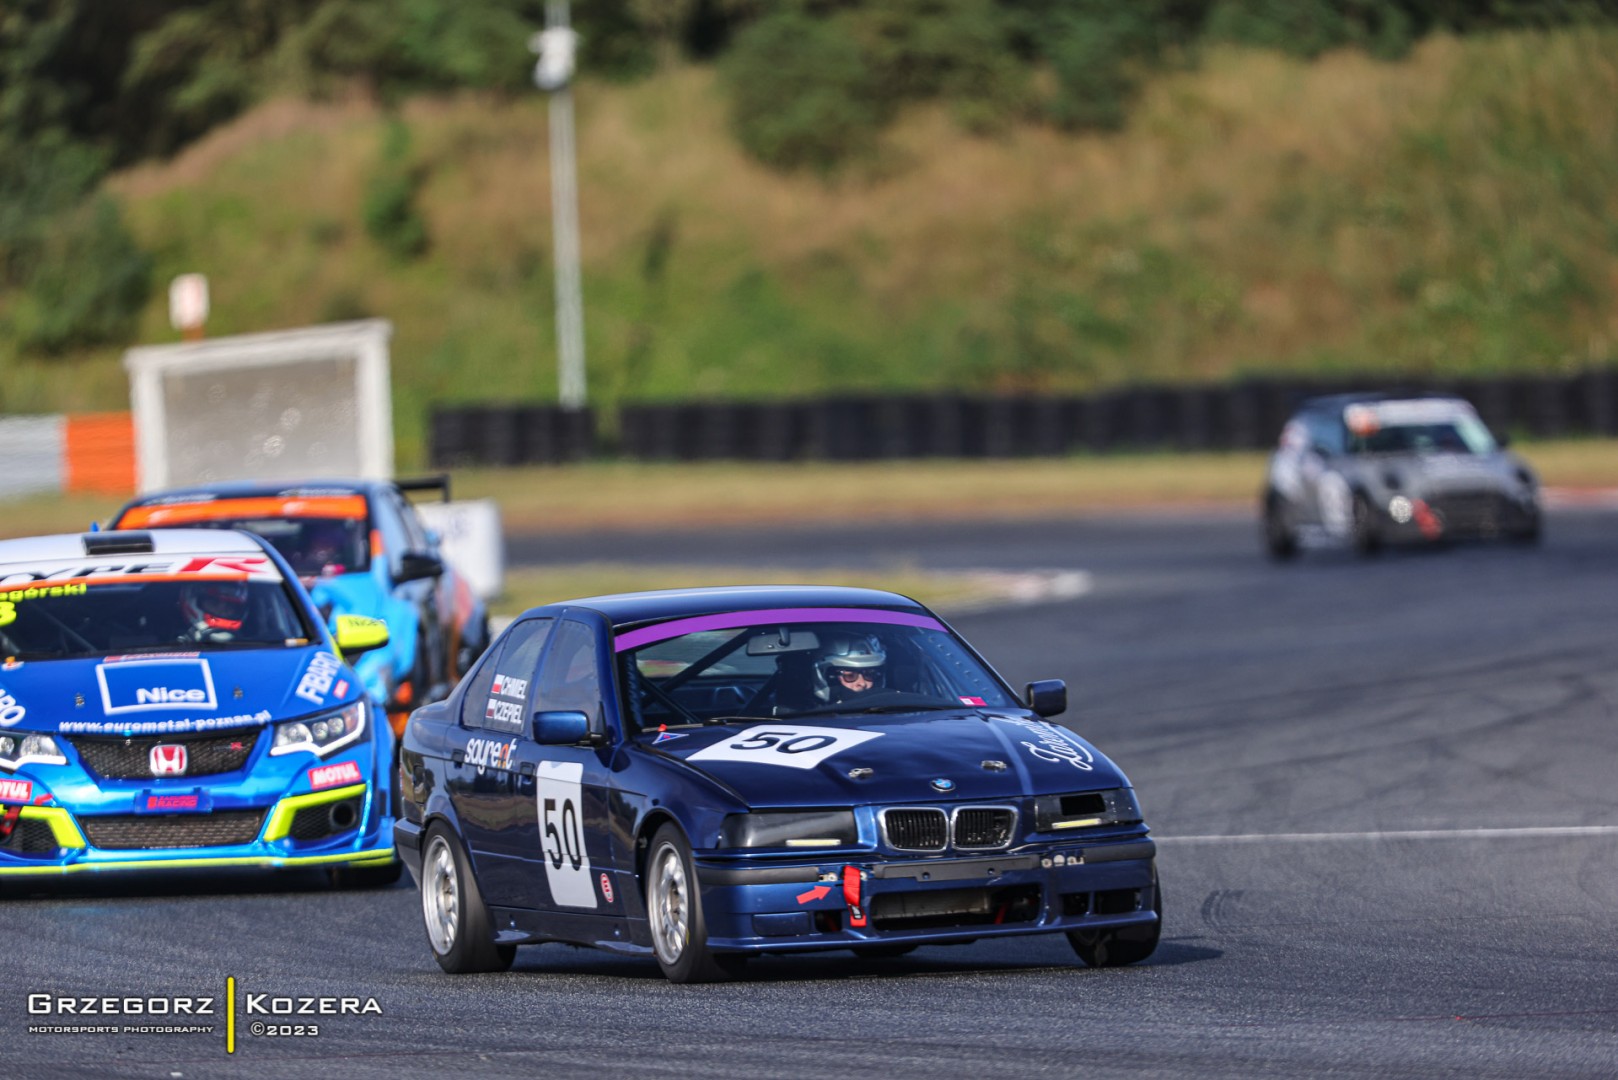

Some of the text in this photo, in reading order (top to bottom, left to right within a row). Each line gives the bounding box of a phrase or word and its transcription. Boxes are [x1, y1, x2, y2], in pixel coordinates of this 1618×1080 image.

[136, 687, 206, 704] Nice
[59, 710, 272, 733] www.eurometal-poznan.pl
[729, 731, 838, 754] 50
[313, 762, 360, 785] MOTUL
[544, 798, 582, 871] 50
